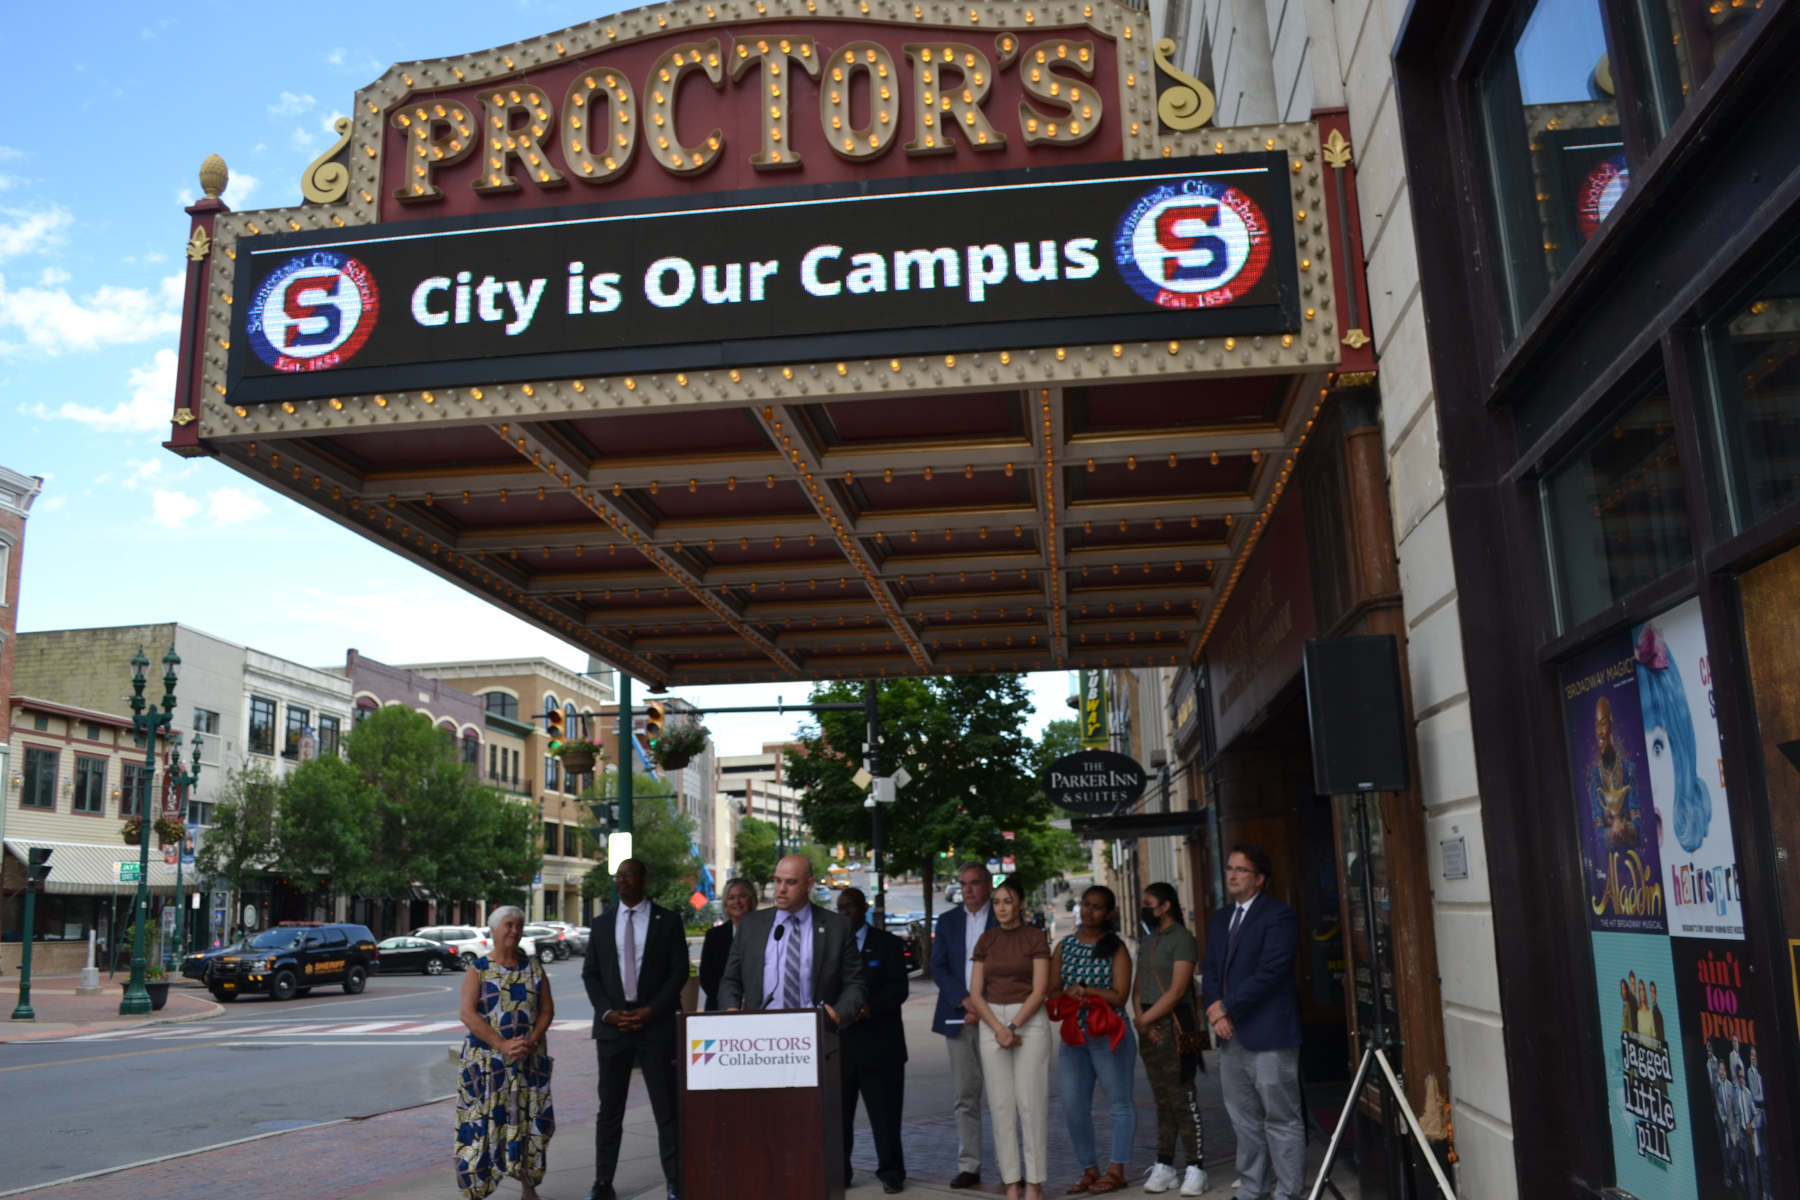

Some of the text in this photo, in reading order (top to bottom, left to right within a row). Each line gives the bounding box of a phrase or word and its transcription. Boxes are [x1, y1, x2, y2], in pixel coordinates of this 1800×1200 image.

[391, 32, 1103, 204] PROCTOR'S
[1182, 179, 1217, 196] City
[311, 251, 340, 267] City
[410, 236, 1100, 336] City is Our Campus
[1082, 762, 1104, 772] THE
[1051, 771, 1138, 788] PARKER INN
[1062, 791, 1128, 803] & SUITES
[1591, 850, 1662, 916] Aladdin
[1642, 920, 1664, 930] MUSICAL
[314, 960, 346, 971] SHERIFF
[1697, 950, 1742, 988] ain't
[1705, 982, 1738, 1015] too
[719, 1036, 811, 1052] PROCTORS
[718, 1052, 811, 1066] Collaborative
[1623, 1032, 1672, 1080] jagged
[1623, 1075, 1674, 1130] little
[1636, 1123, 1670, 1161] pill
